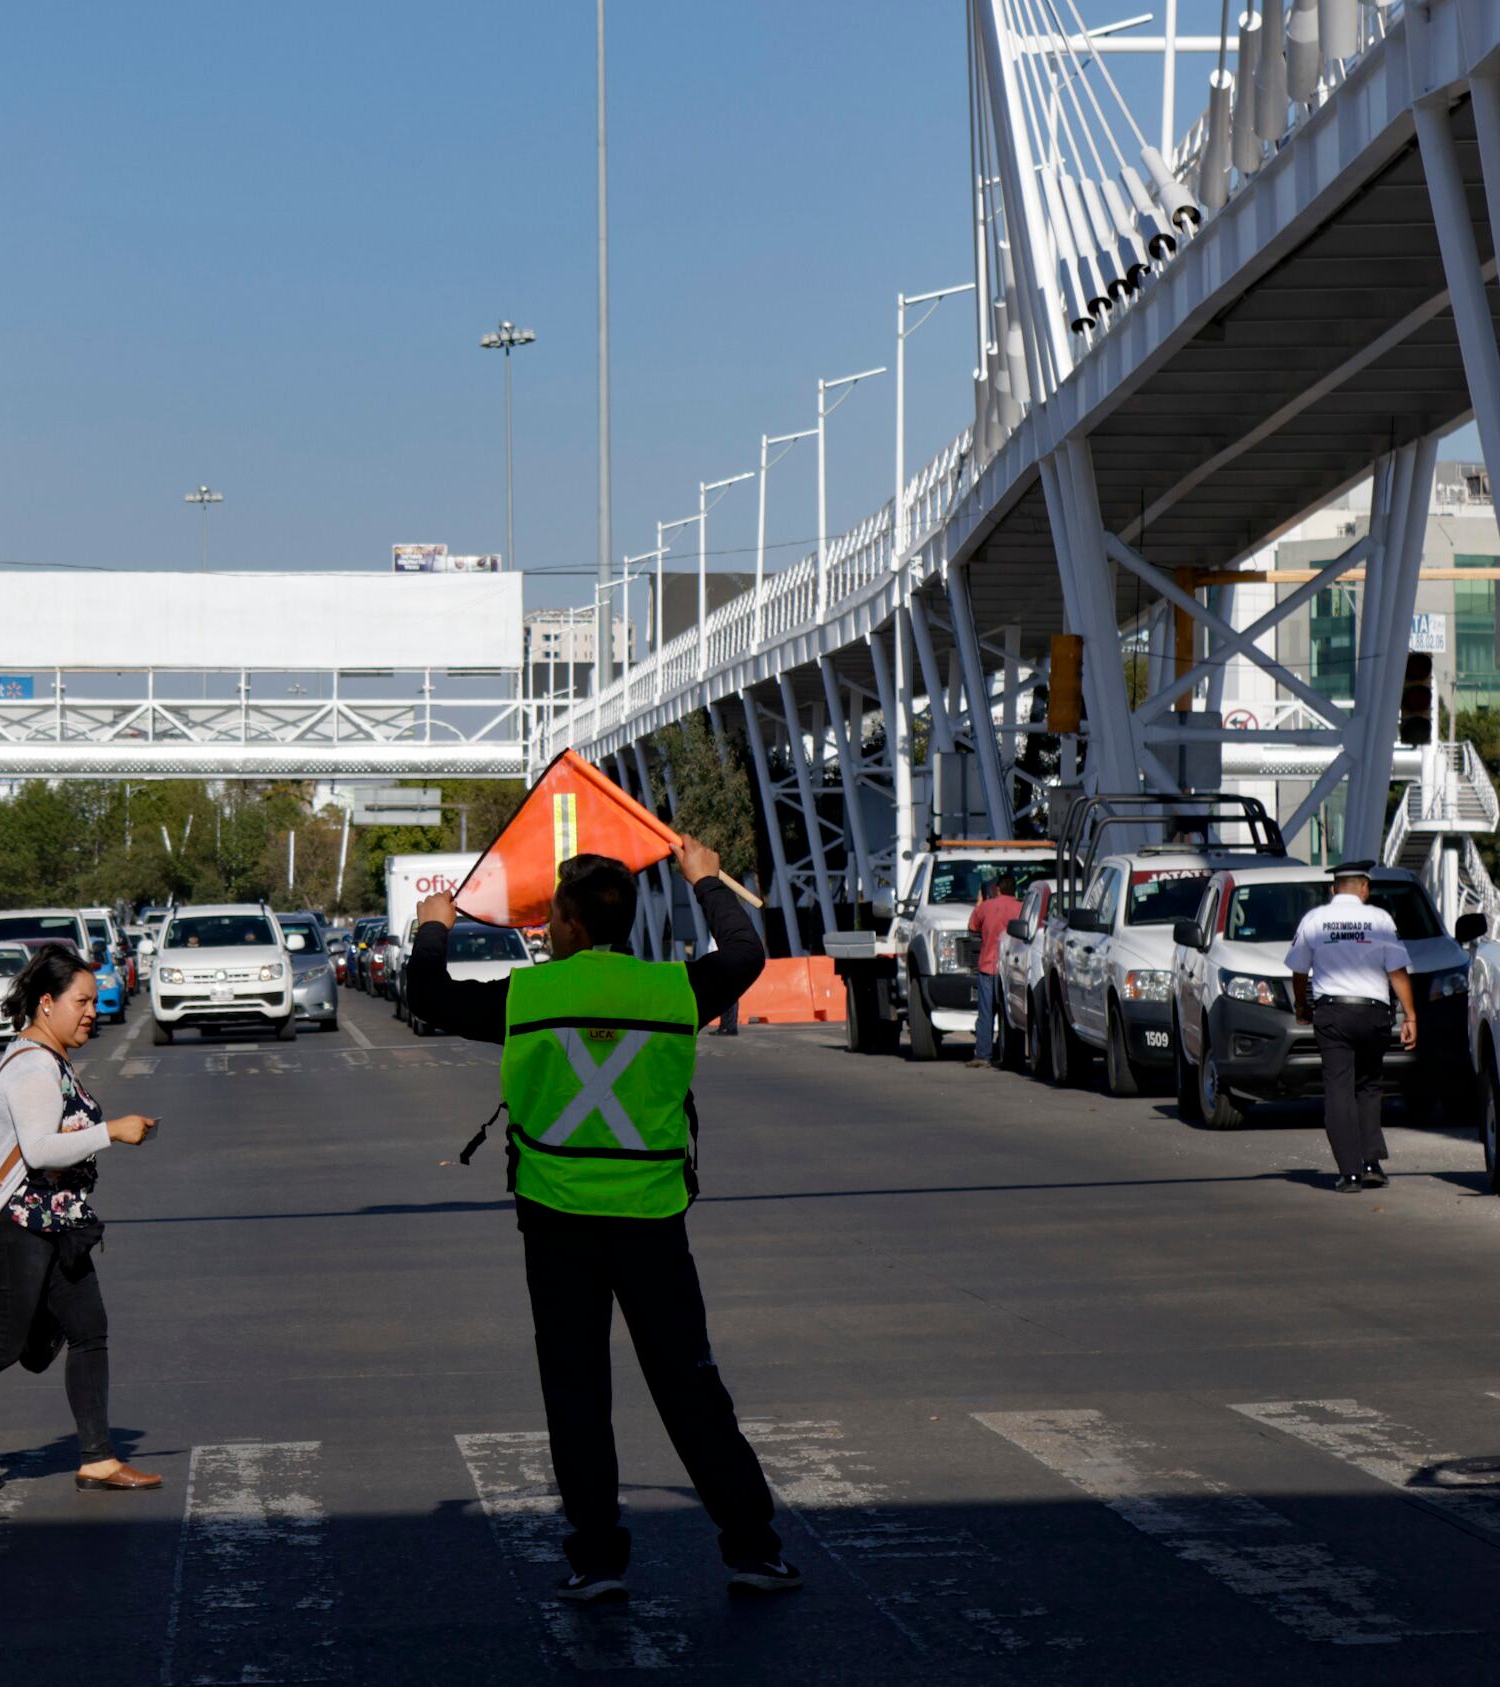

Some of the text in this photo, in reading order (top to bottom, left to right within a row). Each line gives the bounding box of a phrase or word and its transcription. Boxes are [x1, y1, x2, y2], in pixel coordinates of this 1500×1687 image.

[1322, 922, 1373, 931] PROXIMIDAD DE
[1330, 931, 1365, 941] CAMINOS
[1145, 1031, 1169, 1047] 1509
